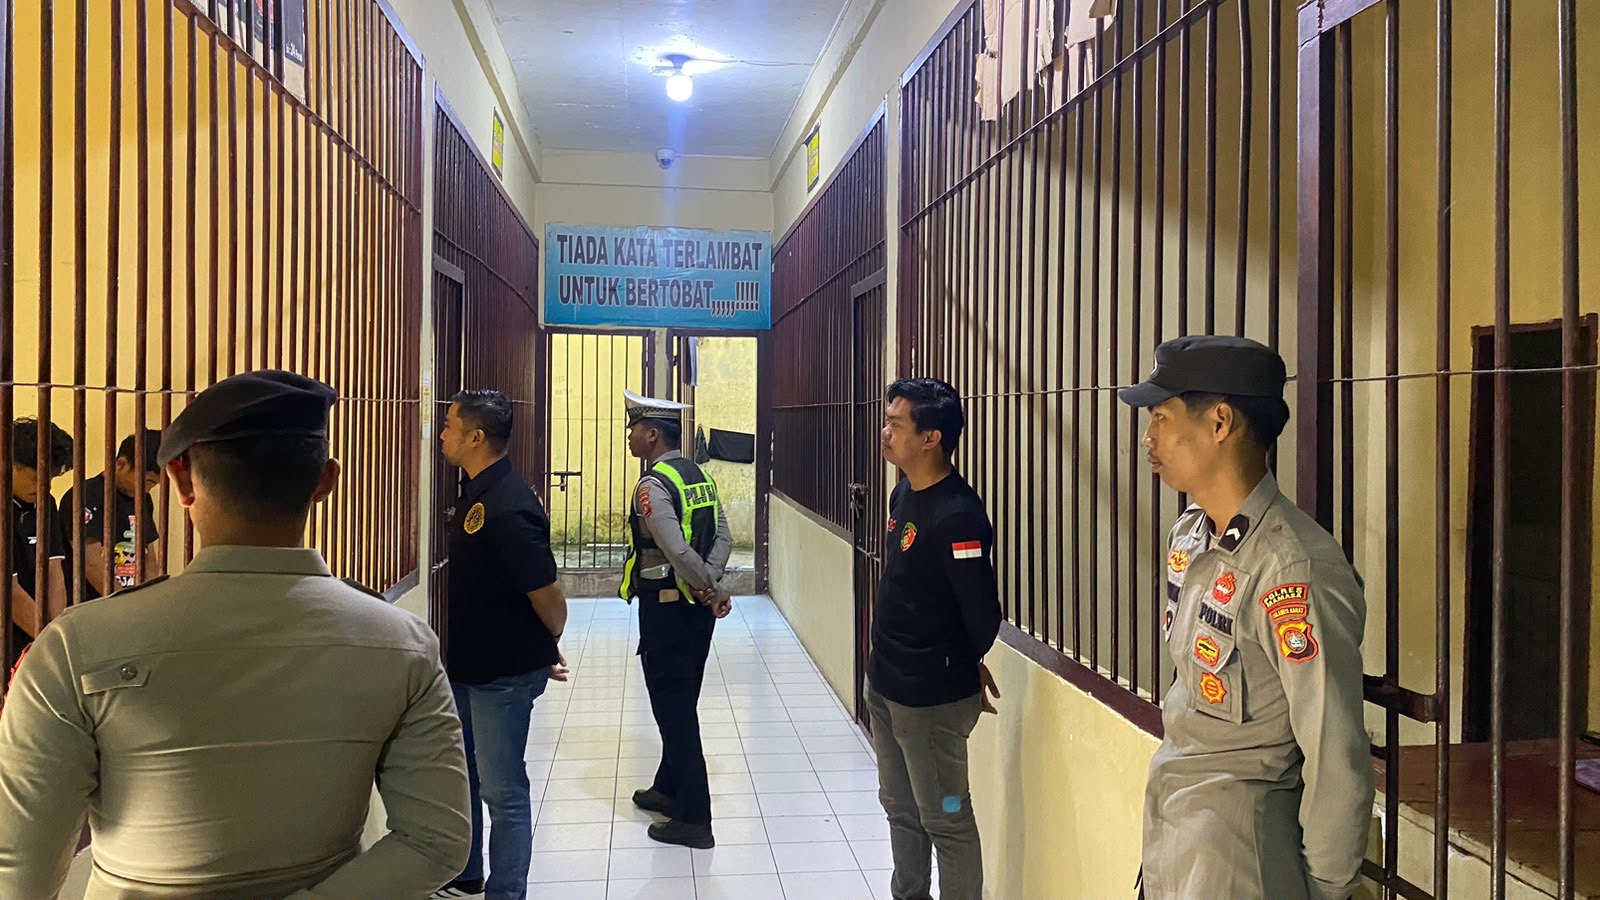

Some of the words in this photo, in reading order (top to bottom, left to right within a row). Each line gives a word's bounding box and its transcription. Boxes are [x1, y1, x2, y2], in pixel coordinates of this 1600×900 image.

[556, 234, 609, 265] TIADA
[613, 236, 658, 268] KATA
[662, 239, 763, 271] TERLAMBAT
[559, 275, 621, 306] UNTUK
[1198, 602, 1233, 635] POLRI
